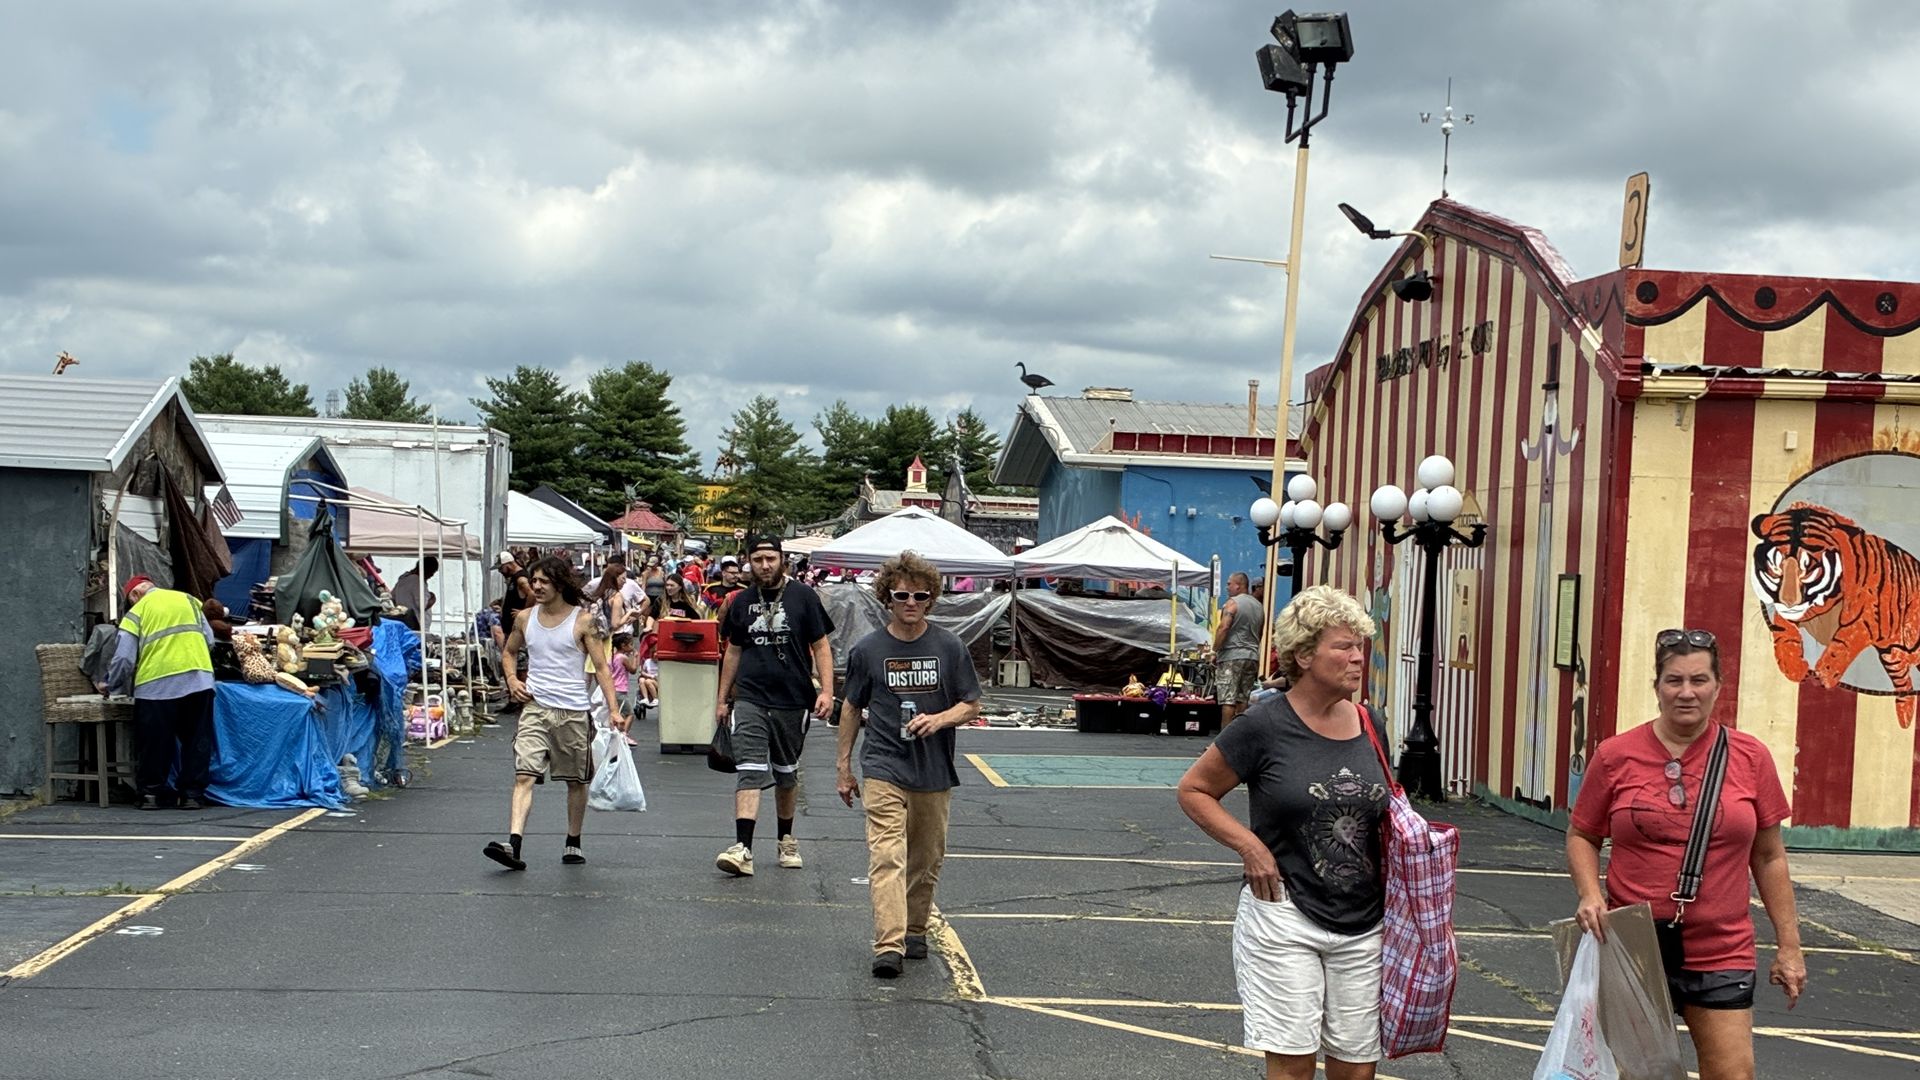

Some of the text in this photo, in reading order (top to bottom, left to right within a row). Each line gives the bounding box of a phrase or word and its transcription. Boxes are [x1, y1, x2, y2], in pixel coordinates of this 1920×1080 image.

[1624, 190, 1641, 251] 3
[768, 601, 784, 612] TE
[751, 635, 789, 646] OLCE
[912, 661, 922, 670] DO
[923, 660, 937, 670] NOT
[887, 670, 938, 687] DISTURB
